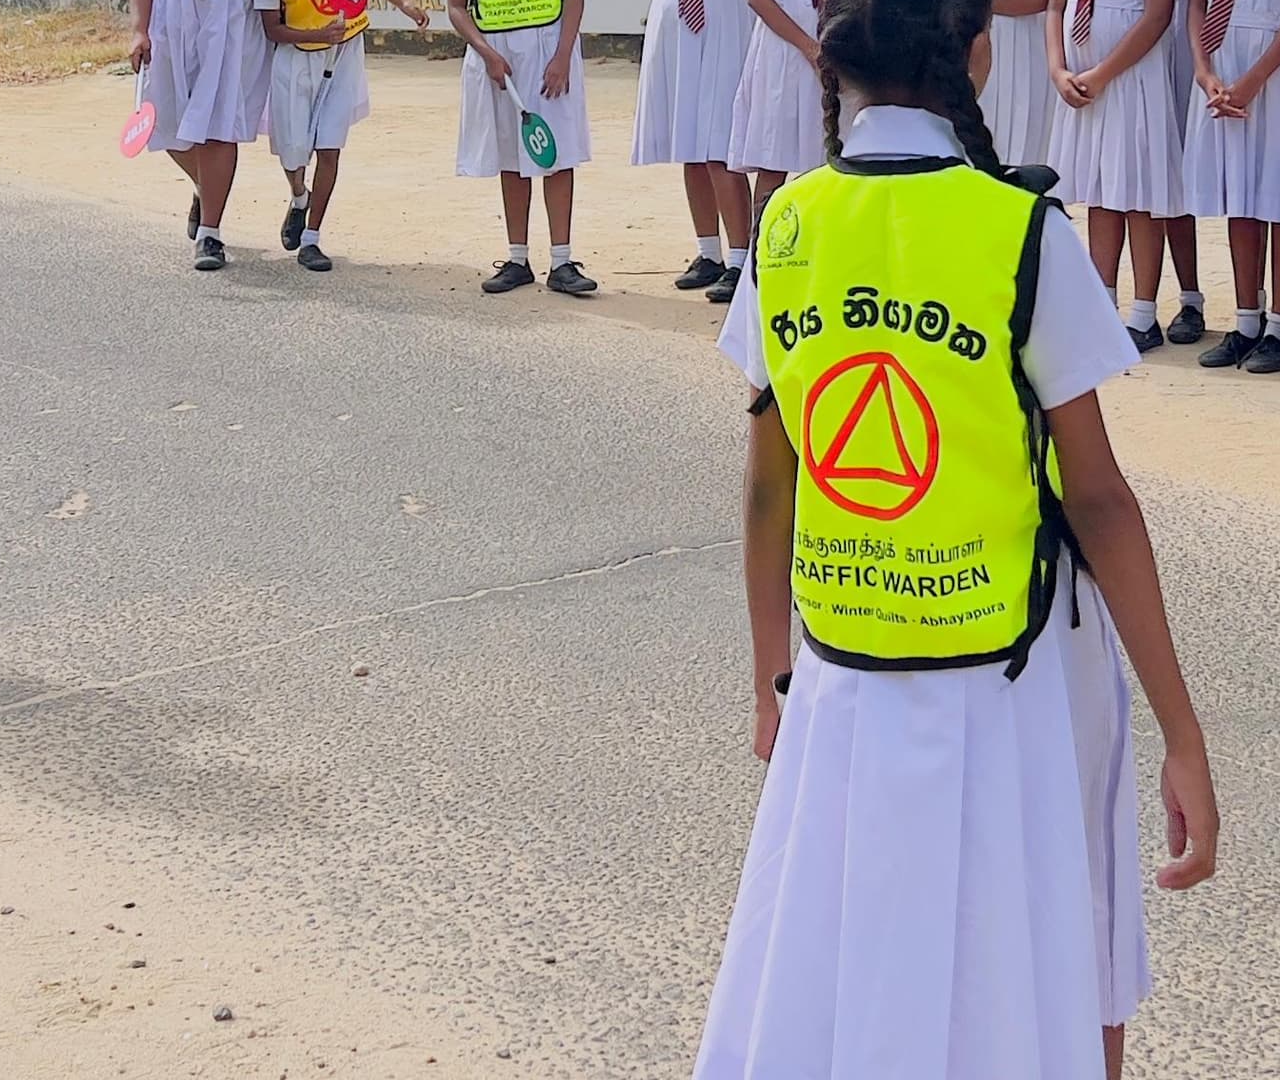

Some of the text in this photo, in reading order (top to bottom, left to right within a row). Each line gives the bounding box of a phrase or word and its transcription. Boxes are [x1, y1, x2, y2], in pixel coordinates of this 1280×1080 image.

[529, 126, 548, 155] GO
[842, 286, 987, 361] නියාමක
[795, 557, 991, 598] RAFFIC WARDEN
[920, 601, 1007, 627] Abhayapura
